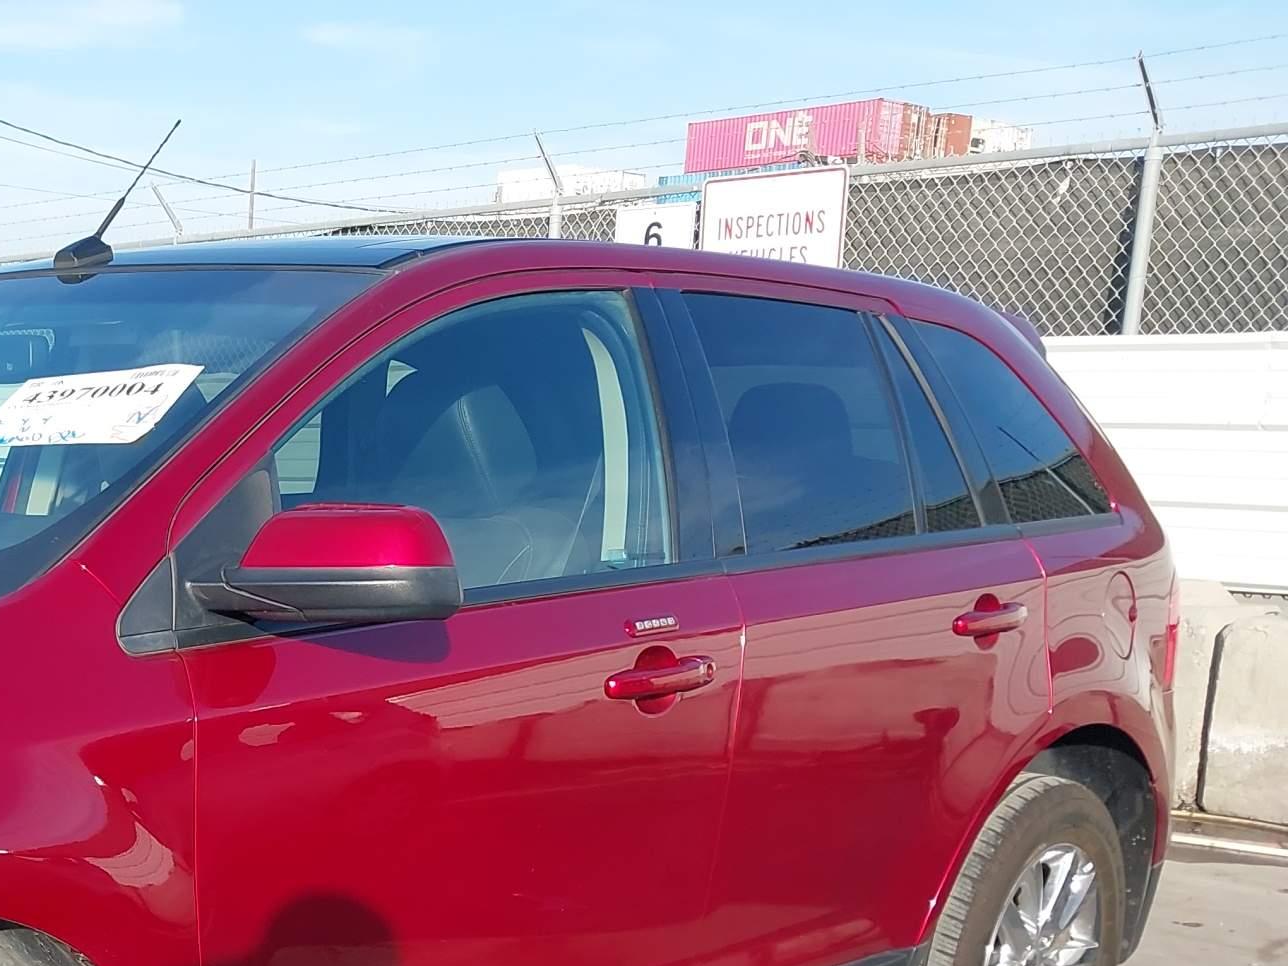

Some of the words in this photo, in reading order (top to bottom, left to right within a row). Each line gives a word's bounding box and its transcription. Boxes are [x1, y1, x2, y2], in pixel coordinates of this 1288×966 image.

[746, 113, 809, 150] ONE
[718, 210, 825, 240] INSPECTIONS
[22, 381, 165, 404] 43970004
